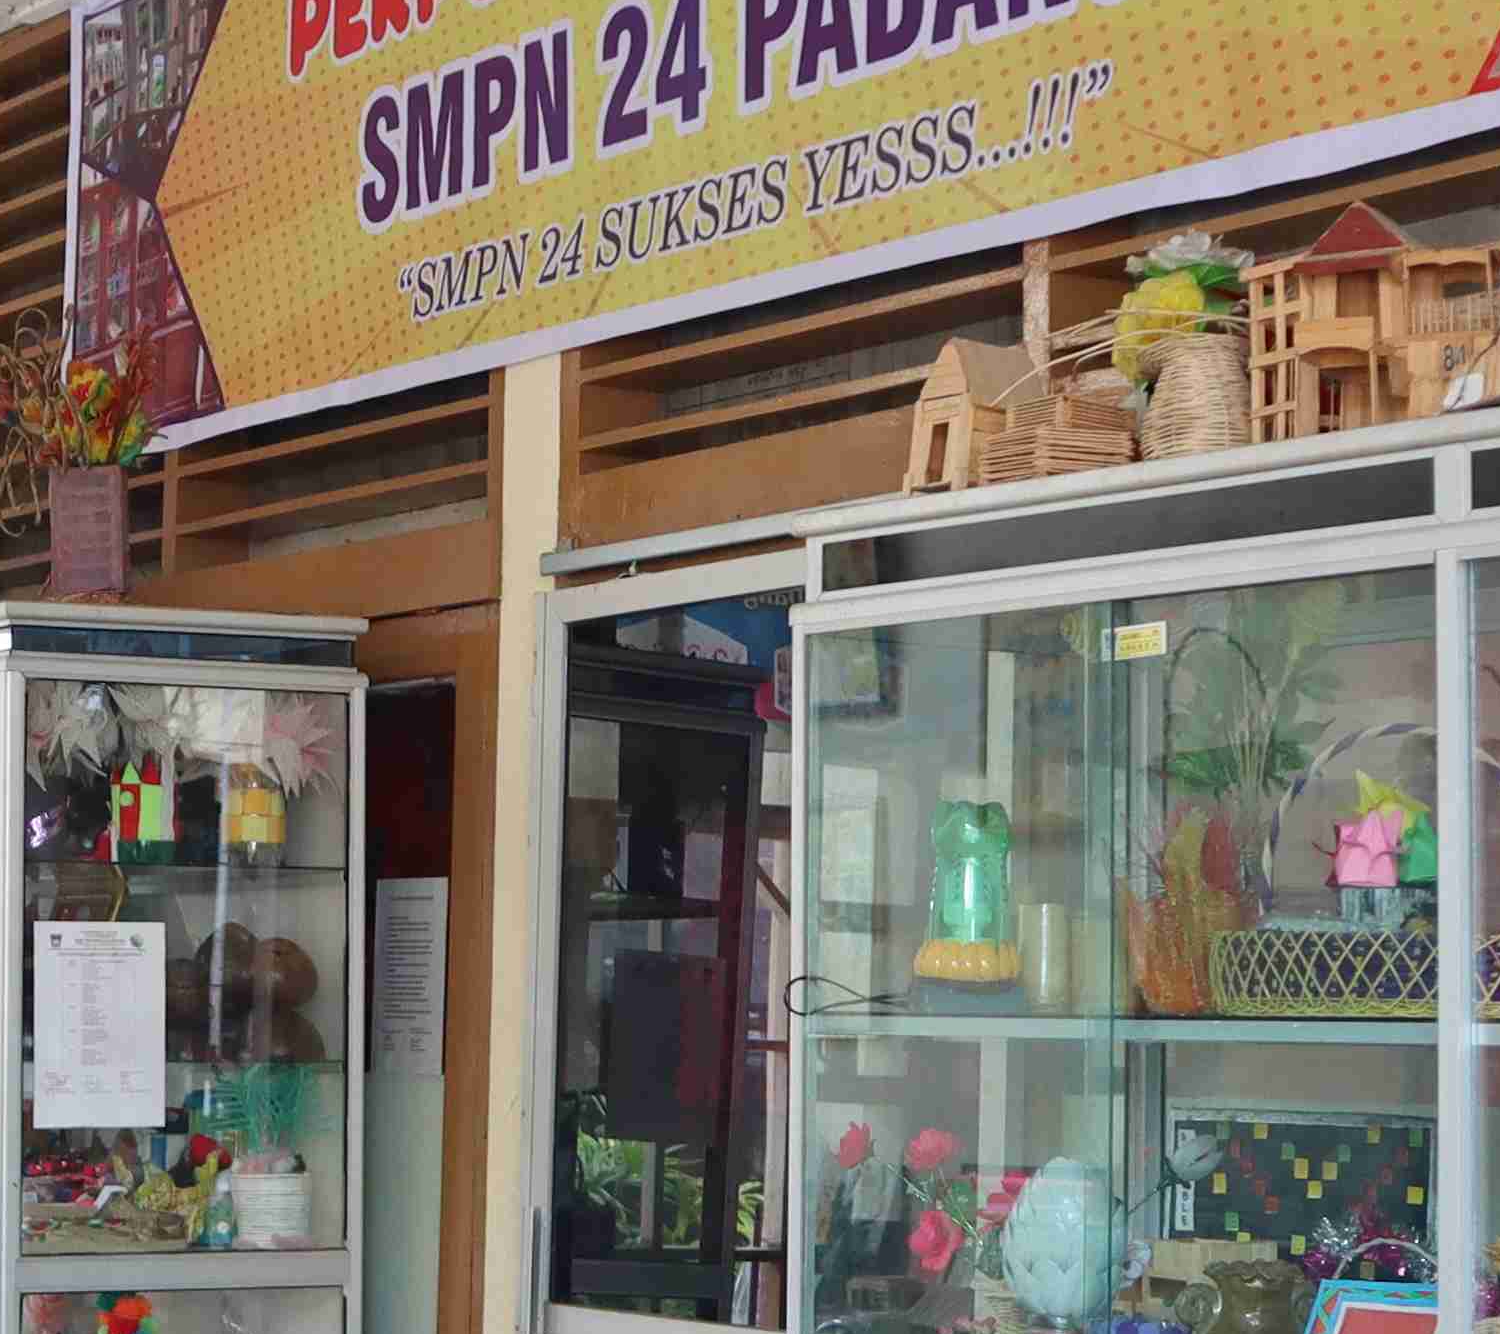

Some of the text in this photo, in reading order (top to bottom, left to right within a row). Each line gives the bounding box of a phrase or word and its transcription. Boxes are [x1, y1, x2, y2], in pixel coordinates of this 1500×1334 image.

[361, 29, 571, 225] SMPN
[538, 219, 584, 283] 24
[597, 158, 788, 268] SUKSES
